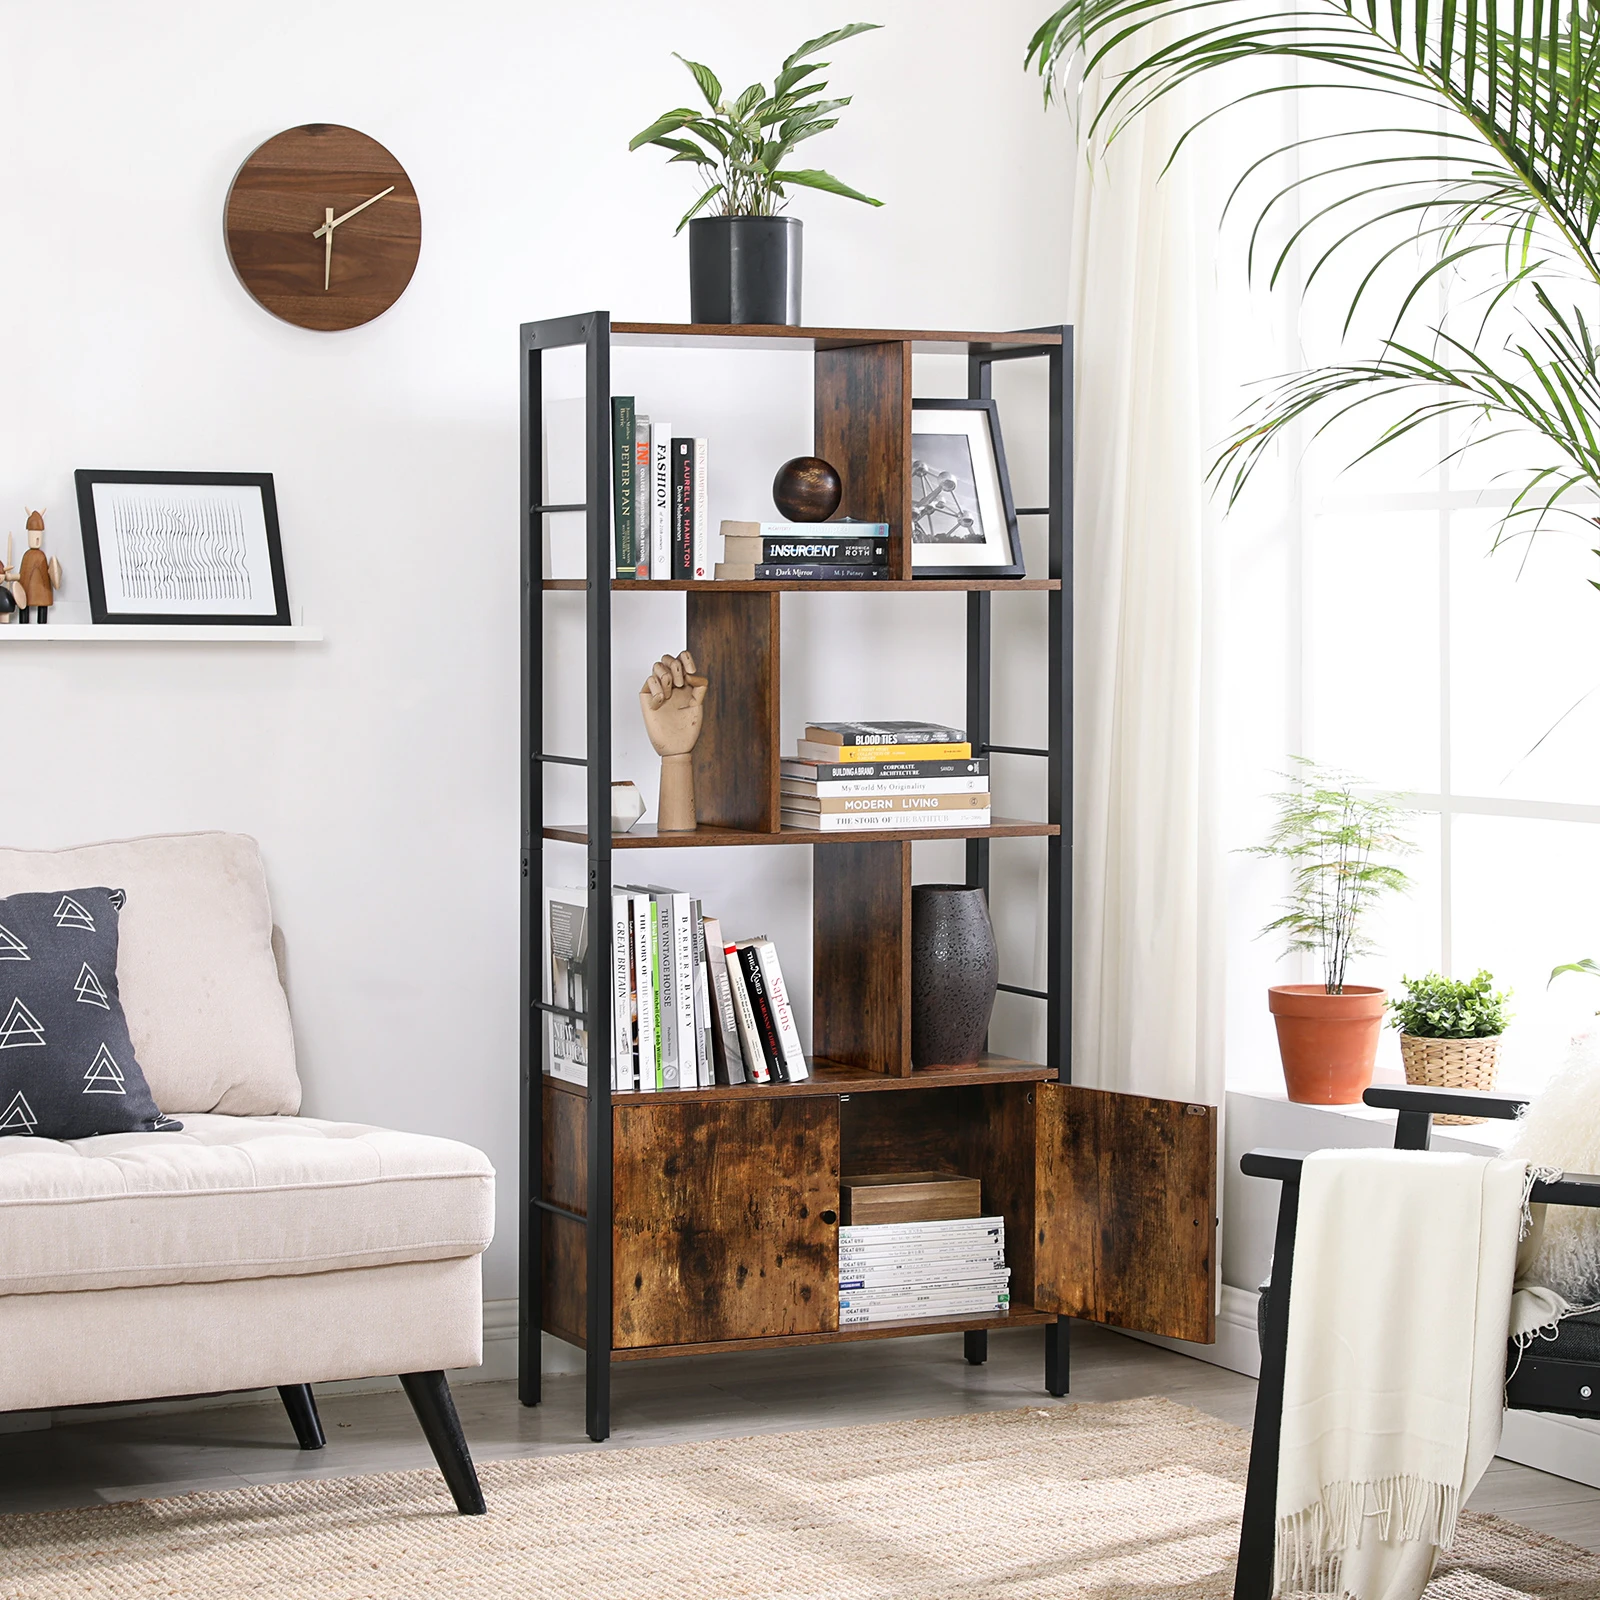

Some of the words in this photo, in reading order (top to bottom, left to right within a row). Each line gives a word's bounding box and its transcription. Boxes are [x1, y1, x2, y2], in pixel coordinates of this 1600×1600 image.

[622, 445, 630, 485] PETER
[637, 442, 649, 464] IN!
[658, 444, 666, 508] FASHION
[622, 490, 630, 516] PAN
[684, 507, 690, 515] K.
[770, 545, 839, 556] INSURGENT
[775, 568, 791, 576] Dark
[792, 569, 813, 577] Mirror
[856, 735, 880, 745] BLOOD
[882, 734, 897, 744] TIES
[854, 783, 874, 791] World
[889, 782, 925, 791] Originality
[845, 799, 893, 810] MODERN
[902, 797, 939, 808] LIVING
[616, 921, 627, 956] GREAT
[662, 930, 670, 972] VINTAGE
[617, 958, 629, 999] BRITAIN
[641, 966, 648, 976] OF
[719, 972, 731, 999] THOMAS
[759, 997, 770, 1030] MARIANNE
[770, 977, 791, 1032] Sapiens
